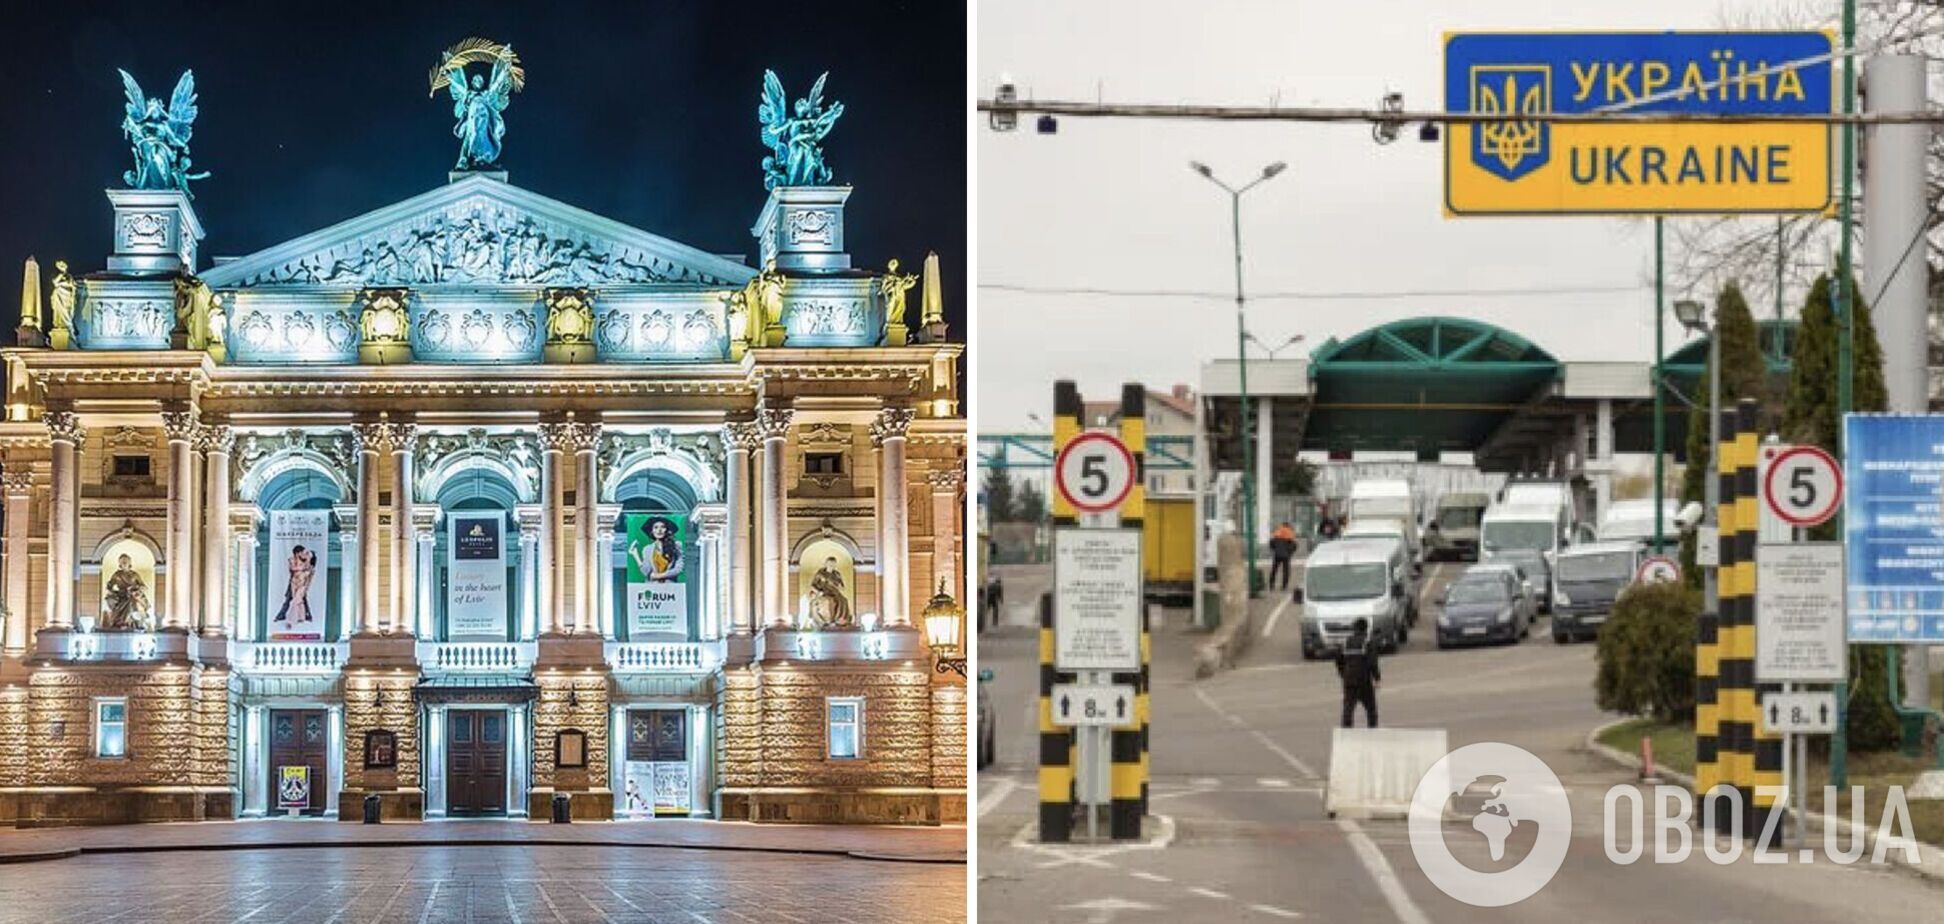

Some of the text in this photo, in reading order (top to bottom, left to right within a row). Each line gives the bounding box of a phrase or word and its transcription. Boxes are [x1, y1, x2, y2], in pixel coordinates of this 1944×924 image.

[1571, 49, 1806, 101] УКРАЇНА
[1570, 145, 1792, 185] UKRAINE
[1081, 455, 1109, 497] 5
[1789, 466, 1817, 508] 5
[637, 601, 662, 610] LVIV
